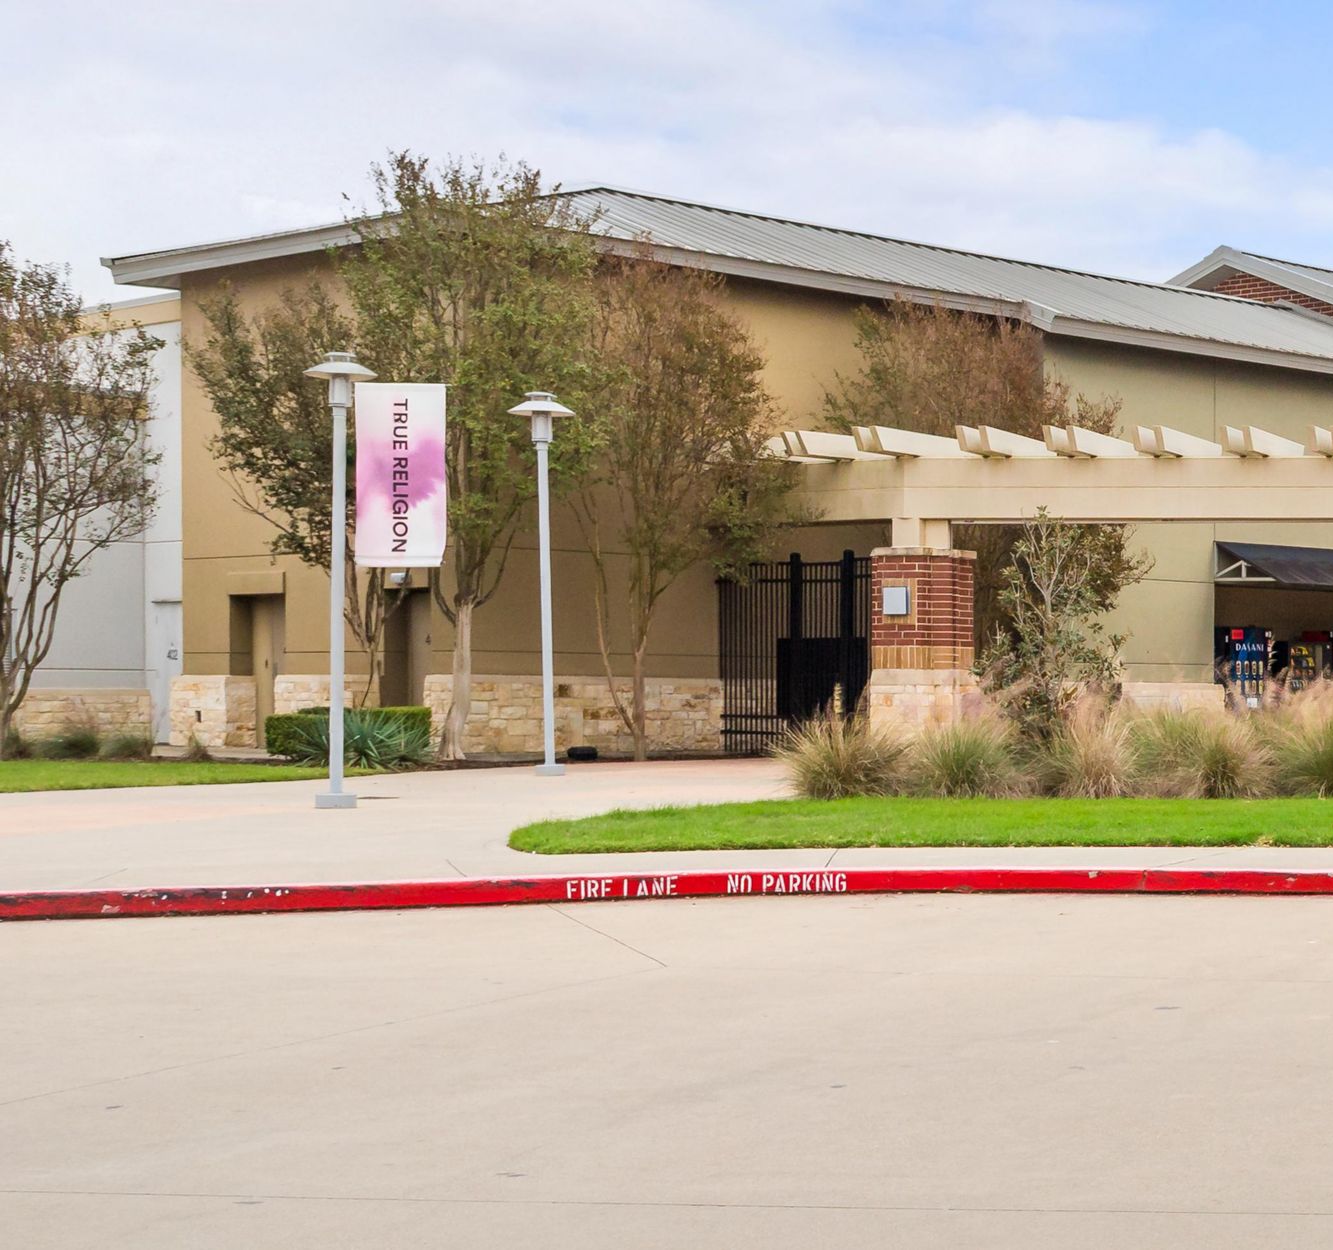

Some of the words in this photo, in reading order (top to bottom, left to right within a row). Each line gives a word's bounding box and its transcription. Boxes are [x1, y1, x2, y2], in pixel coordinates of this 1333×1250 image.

[393, 398, 408, 450] TRUE
[391, 457, 409, 552] RELIGION
[1235, 642, 1264, 652] DASANI
[727, 874, 752, 893] NO
[762, 873, 847, 893] PARKING
